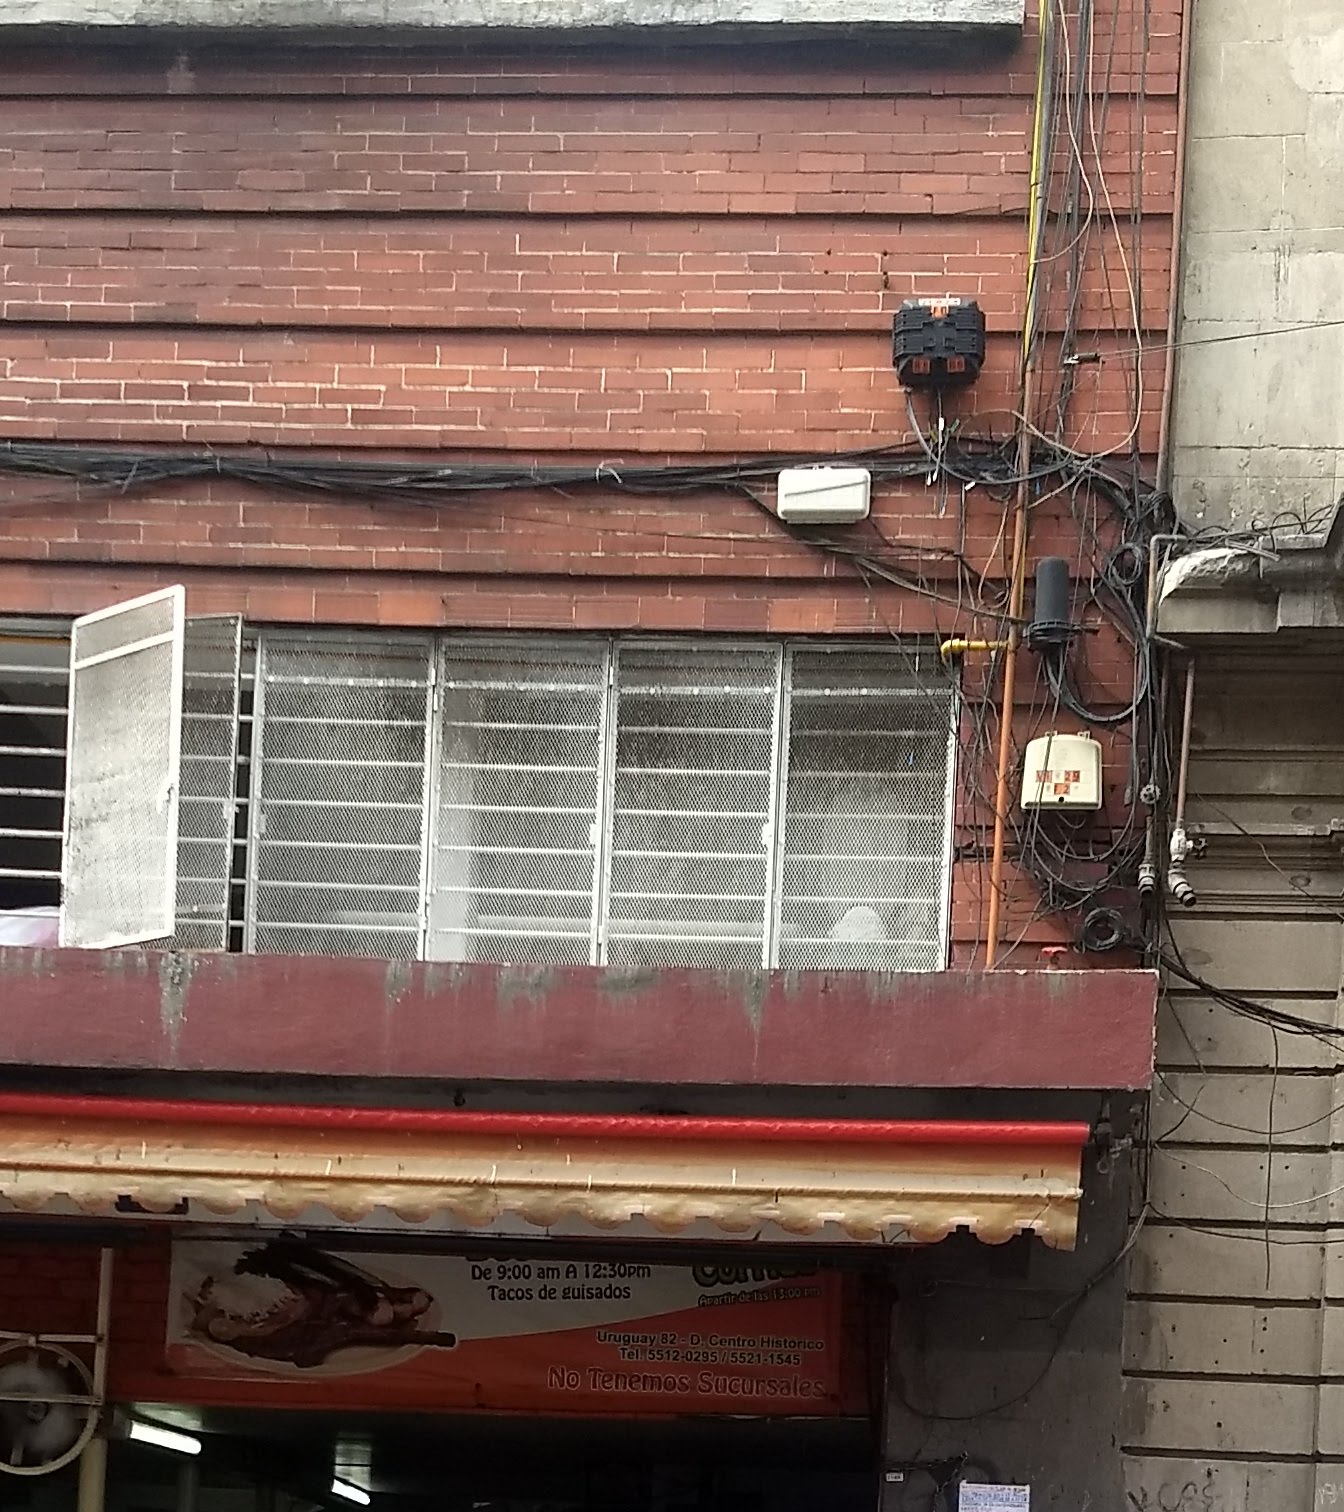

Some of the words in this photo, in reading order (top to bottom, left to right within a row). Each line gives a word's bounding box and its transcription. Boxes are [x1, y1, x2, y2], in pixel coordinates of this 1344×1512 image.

[471, 1264, 492, 1281] De
[497, 1265, 532, 1280] 9:00
[537, 1267, 560, 1280] am
[566, 1263, 578, 1279] A
[487, 1284, 534, 1301] Tacos
[538, 1284, 557, 1300] de
[562, 1283, 631, 1300] guisados
[597, 1331, 656, 1347] Uruguay
[660, 1333, 677, 1345] 82
[709, 1335, 756, 1348] Centro
[619, 1347, 643, 1361] Tel.
[648, 1349, 718, 1363] 5512-0295
[730, 1351, 801, 1366] 5521-1545
[548, 1366, 580, 1390] No
[586, 1367, 690, 1394] Tenemos
[698, 1371, 826, 1398] Sucursales
